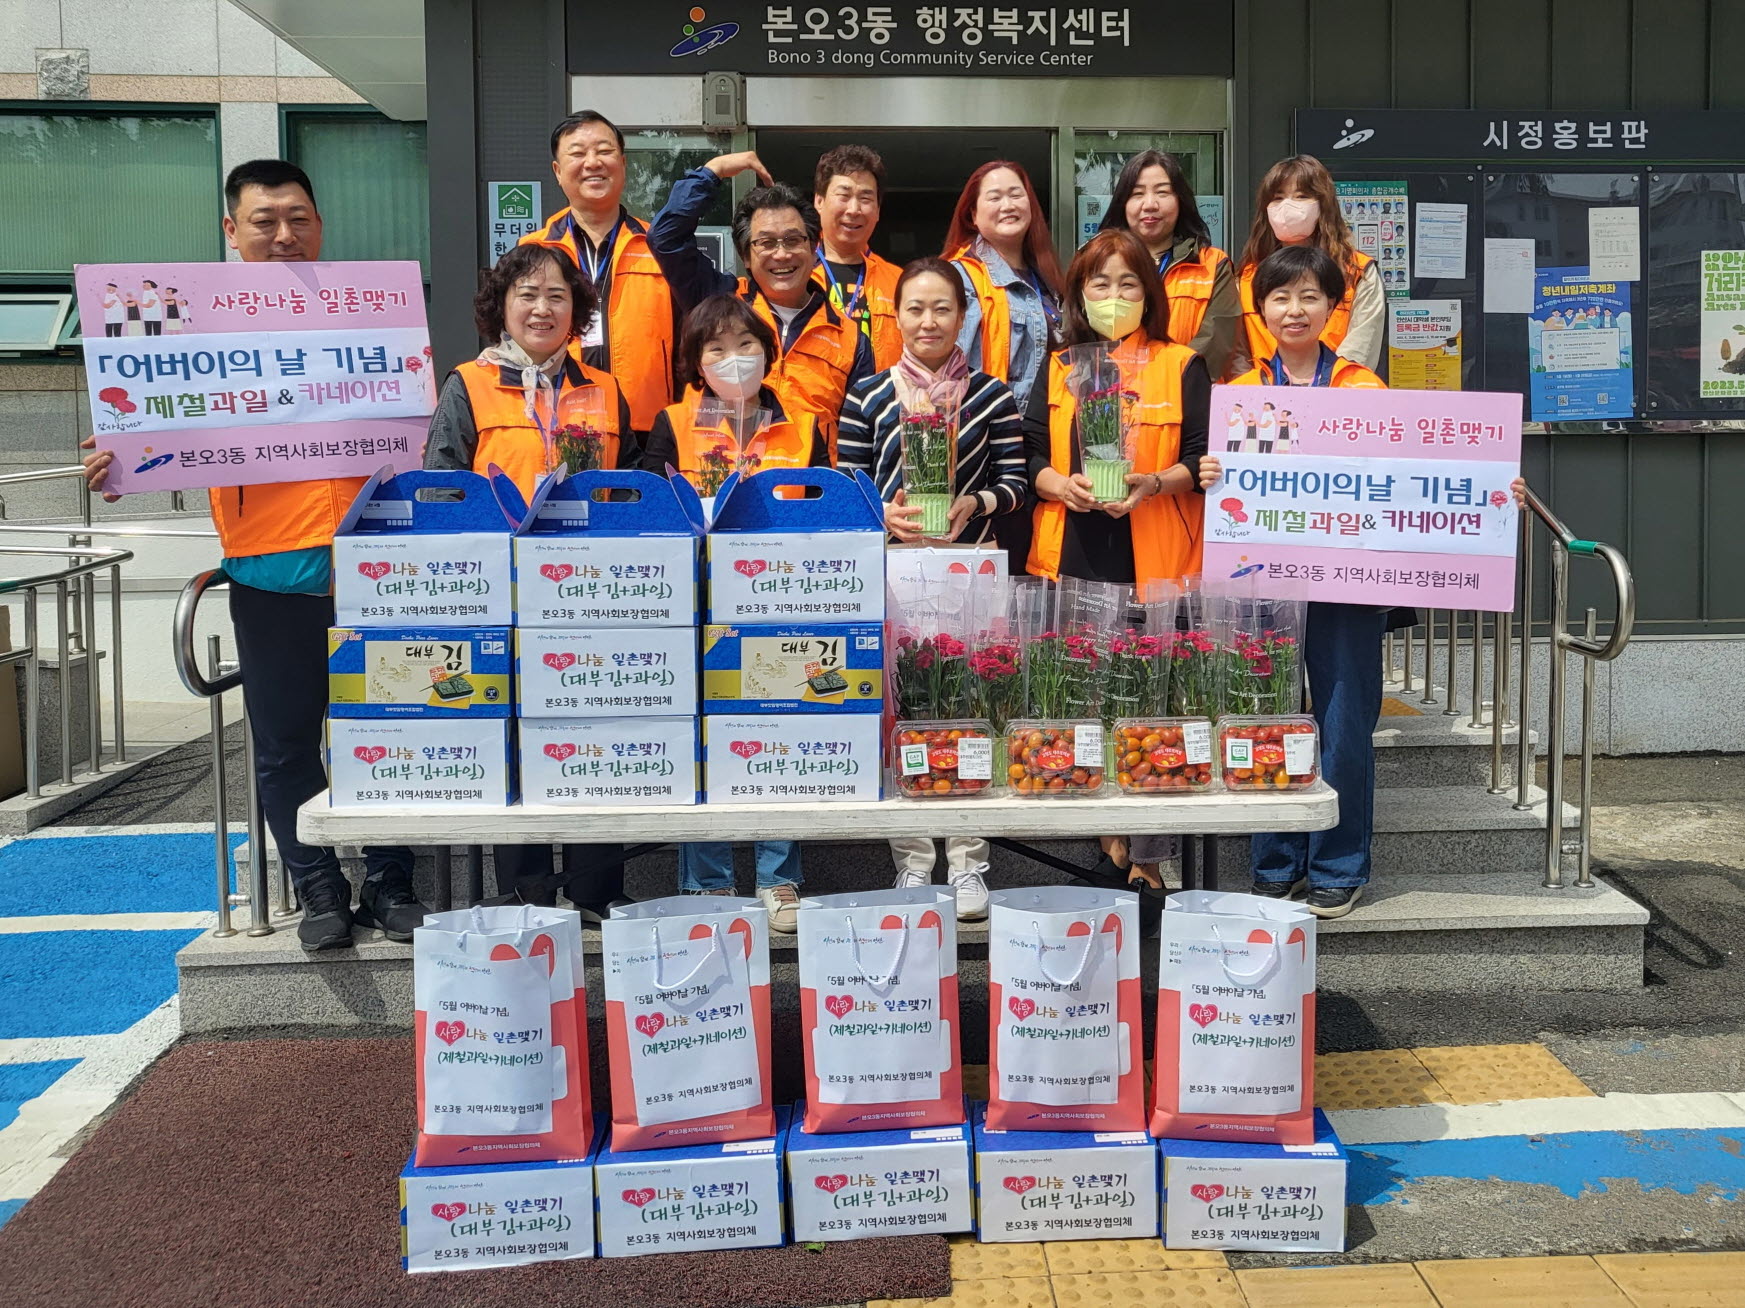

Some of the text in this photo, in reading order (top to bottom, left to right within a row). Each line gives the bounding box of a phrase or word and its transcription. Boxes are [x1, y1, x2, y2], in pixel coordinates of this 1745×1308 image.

[762, 6, 1132, 47] 본오3동 행정복지센터
[768, 49, 1094, 68] Bono 3 dong Community Service Center
[1482, 119, 1649, 150] 시정홍보판
[1362, 236, 1375, 245] 112
[1542, 283, 1616, 296] 청년내일저축계좌
[211, 288, 408, 316] 사랑나눔 일촌맺기
[1396, 323, 1421, 332] 등록금
[1422, 323, 1439, 332] 반값
[275, 349, 307, 376] 날
[144, 388, 269, 419] 제철과일
[298, 379, 401, 405] 카네이션
[1318, 417, 1504, 445] 사랑나눔 일촌맺기
[179, 436, 409, 468] 본오3동 지역사회보장협의체
[426, 561, 482, 575] 일촌맺기
[609, 564, 665, 579] 일촌맺기
[802, 560, 857, 573] 일촌맺기
[1267, 562, 1480, 590] 본오3동 지역사회보장협의체
[361, 605, 488, 617] 본오3동 지역사회보장협의체
[542, 609, 670, 619] 본오3동 지역사회보장협의체
[736, 603, 861, 614] 본오3동 지역사회보장협의체
[405, 643, 463, 671] 대부 김
[781, 638, 839, 666] 대부 김
[422, 746, 477, 760] 일촌맺기
[611, 742, 666, 756] 일촌맺기
[356, 789, 483, 801] 본오3동 지역사회보장협의체
[546, 785, 672, 797] 본오3동 지역사회보장협의체
[884, 998, 932, 1011] 일촌맺기
[1065, 1001, 1110, 1017] 일촌맺기
[695, 1003, 744, 1022] 일촌맺기
[1248, 1013, 1296, 1026] 일촌맺기
[493, 1030, 543, 1042] 일촌맺기
[829, 1020, 932, 1037] (제철과일+카네이션)
[1011, 1024, 1110, 1041] (제철과일+카네이션)
[642, 1025, 747, 1057] (제철과일+카네이션)
[1192, 1033, 1296, 1048] (제철과일+카네이션)
[437, 1050, 544, 1067] (제철과일+카네이션)
[828, 1071, 932, 1083] 본오3동 지역사회보장협의체
[1008, 1074, 1111, 1086] 본오3동 지역사회보장협의체
[646, 1077, 753, 1105] 본오3동 지역사회보장협의체
[1189, 1084, 1295, 1094] 본오3동 지역사회보장협의체
[434, 1103, 544, 1115] 본오3동 지역사회보장협의체
[884, 1169, 940, 1185] 일촌맺기
[1261, 1185, 1317, 1200] 일촌맺기
[504, 1196, 563, 1214] 일촌맺기
[818, 1212, 947, 1231] 본오3동 지역사회보장협의체
[1191, 1230, 1320, 1240] 본오3동 지역사회보장협의체
[434, 1241, 569, 1260] 본오3동 지역사회보장협의체
